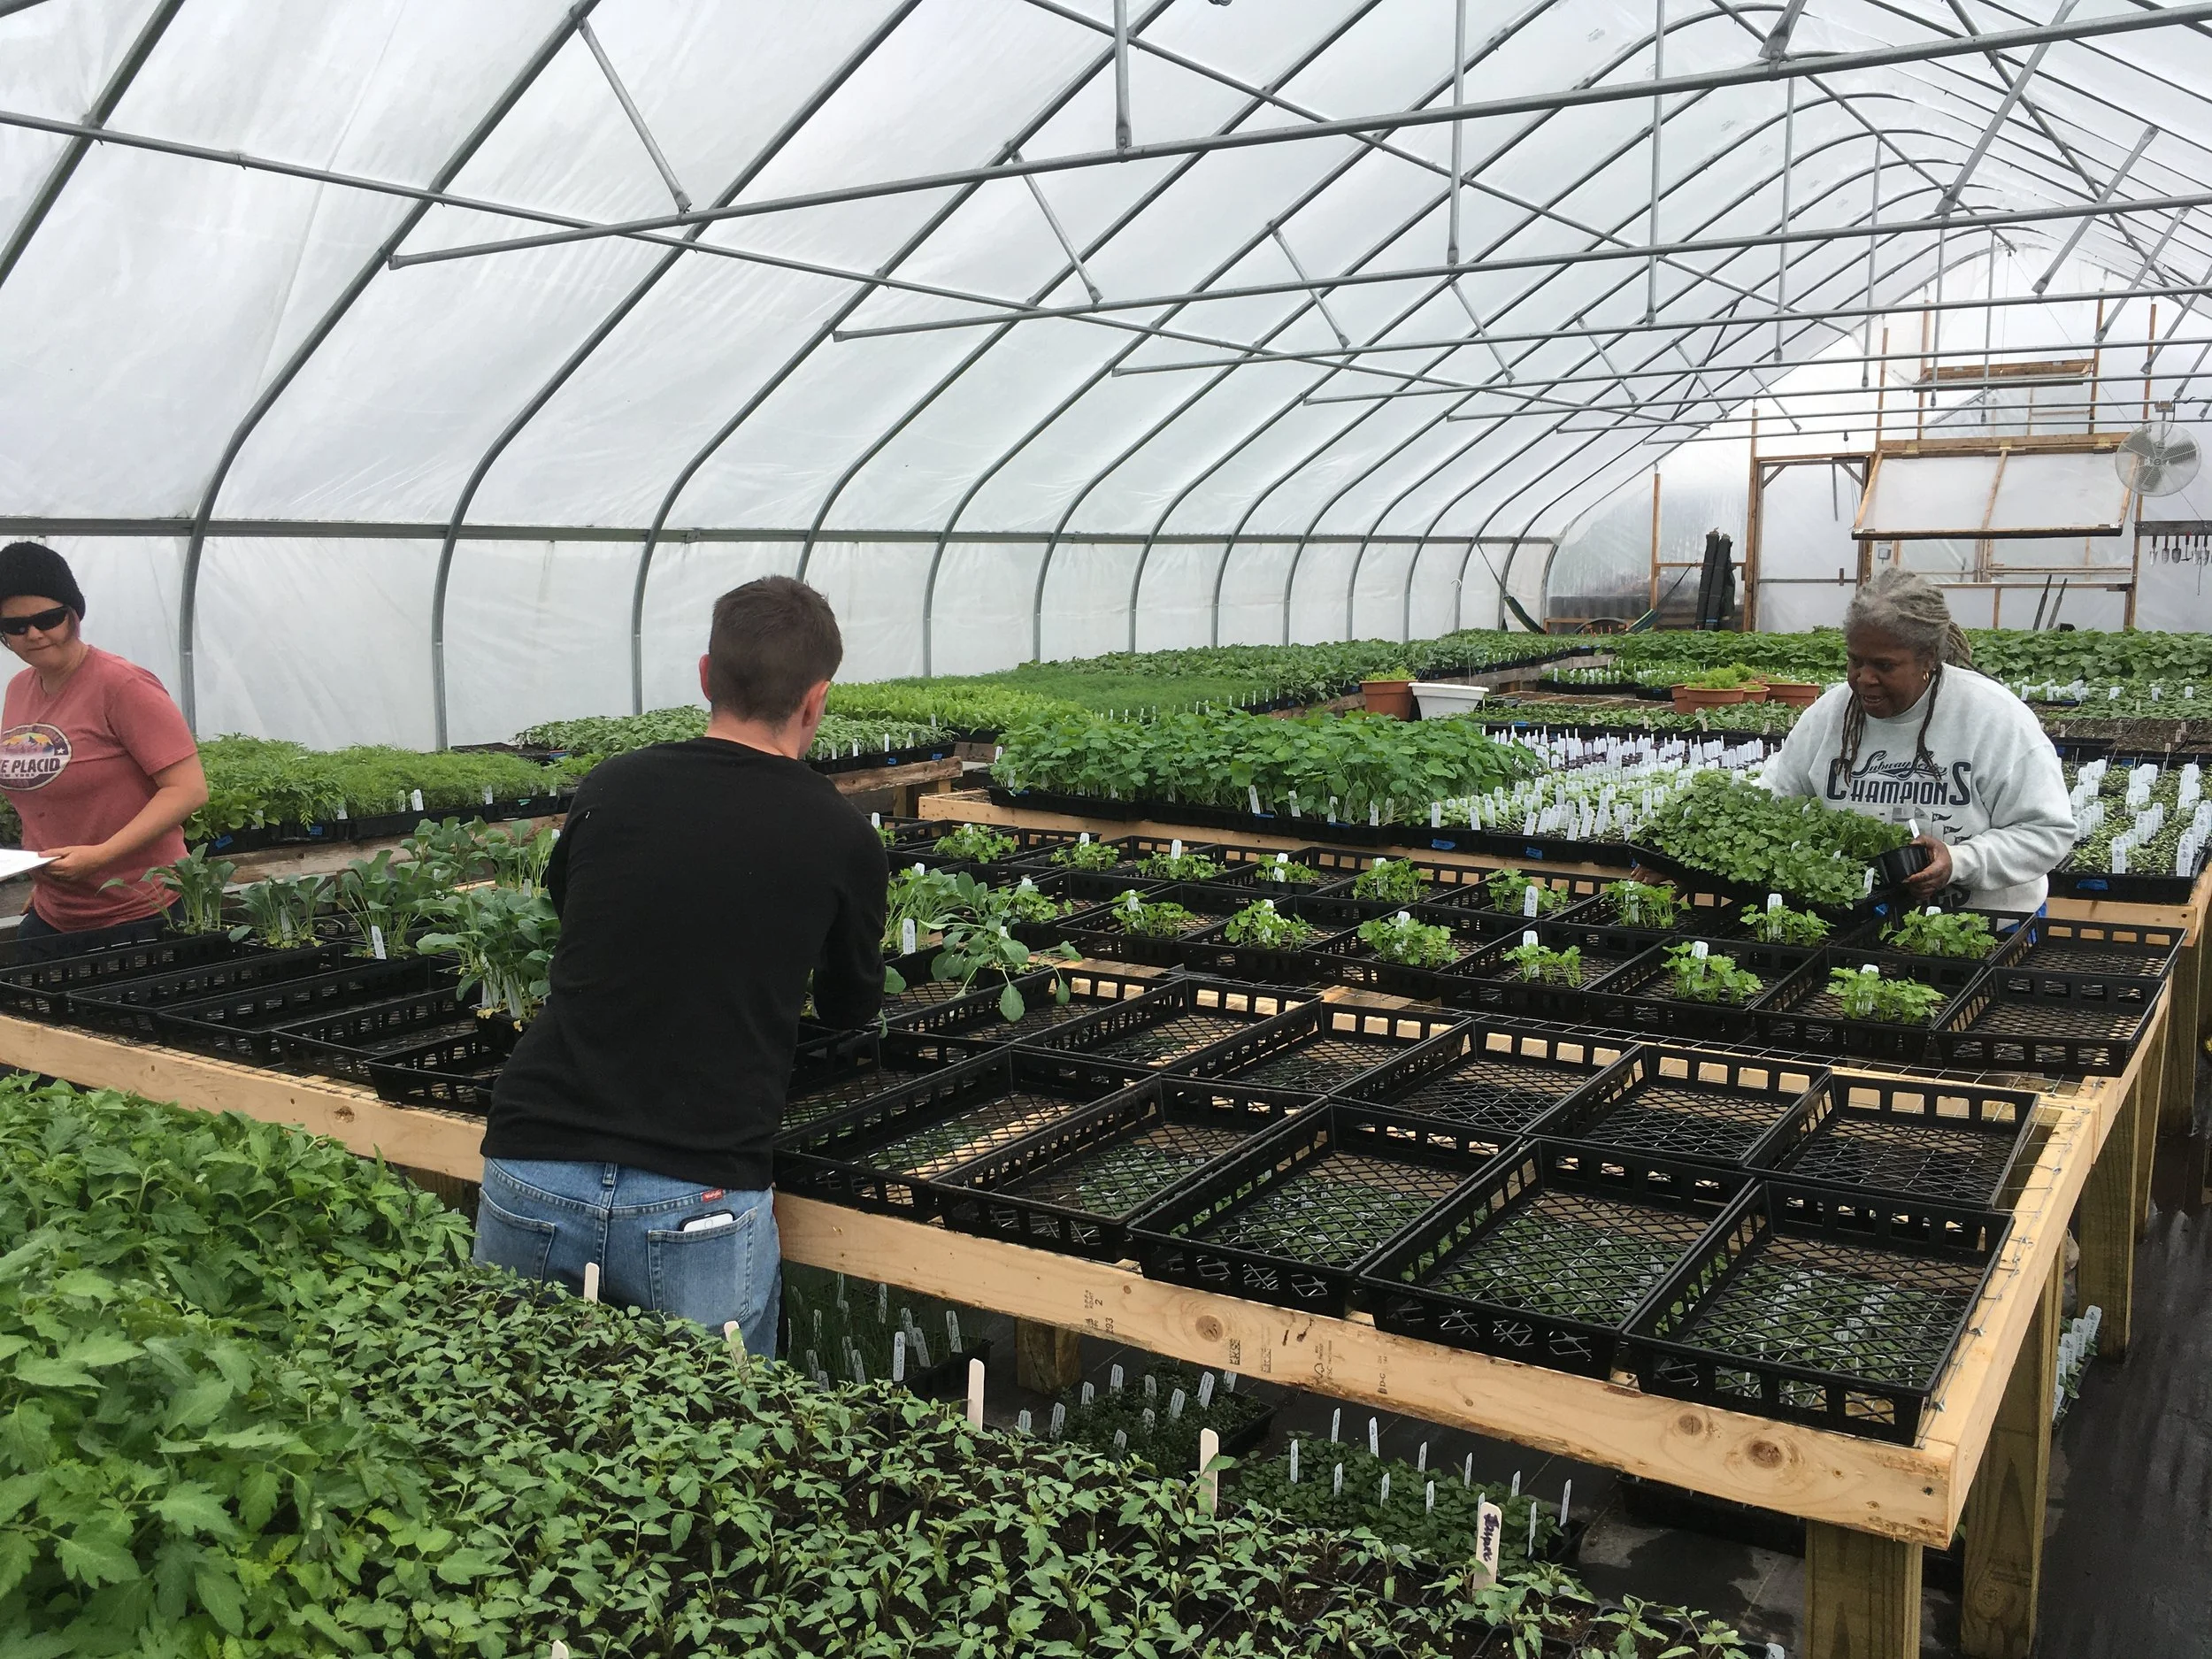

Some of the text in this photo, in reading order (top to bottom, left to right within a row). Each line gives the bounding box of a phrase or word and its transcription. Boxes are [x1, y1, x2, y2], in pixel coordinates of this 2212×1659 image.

[12, 758, 61, 772] PLACID
[1851, 750, 1912, 778] Subway
[1826, 758, 1971, 806] CHAMPIONS
